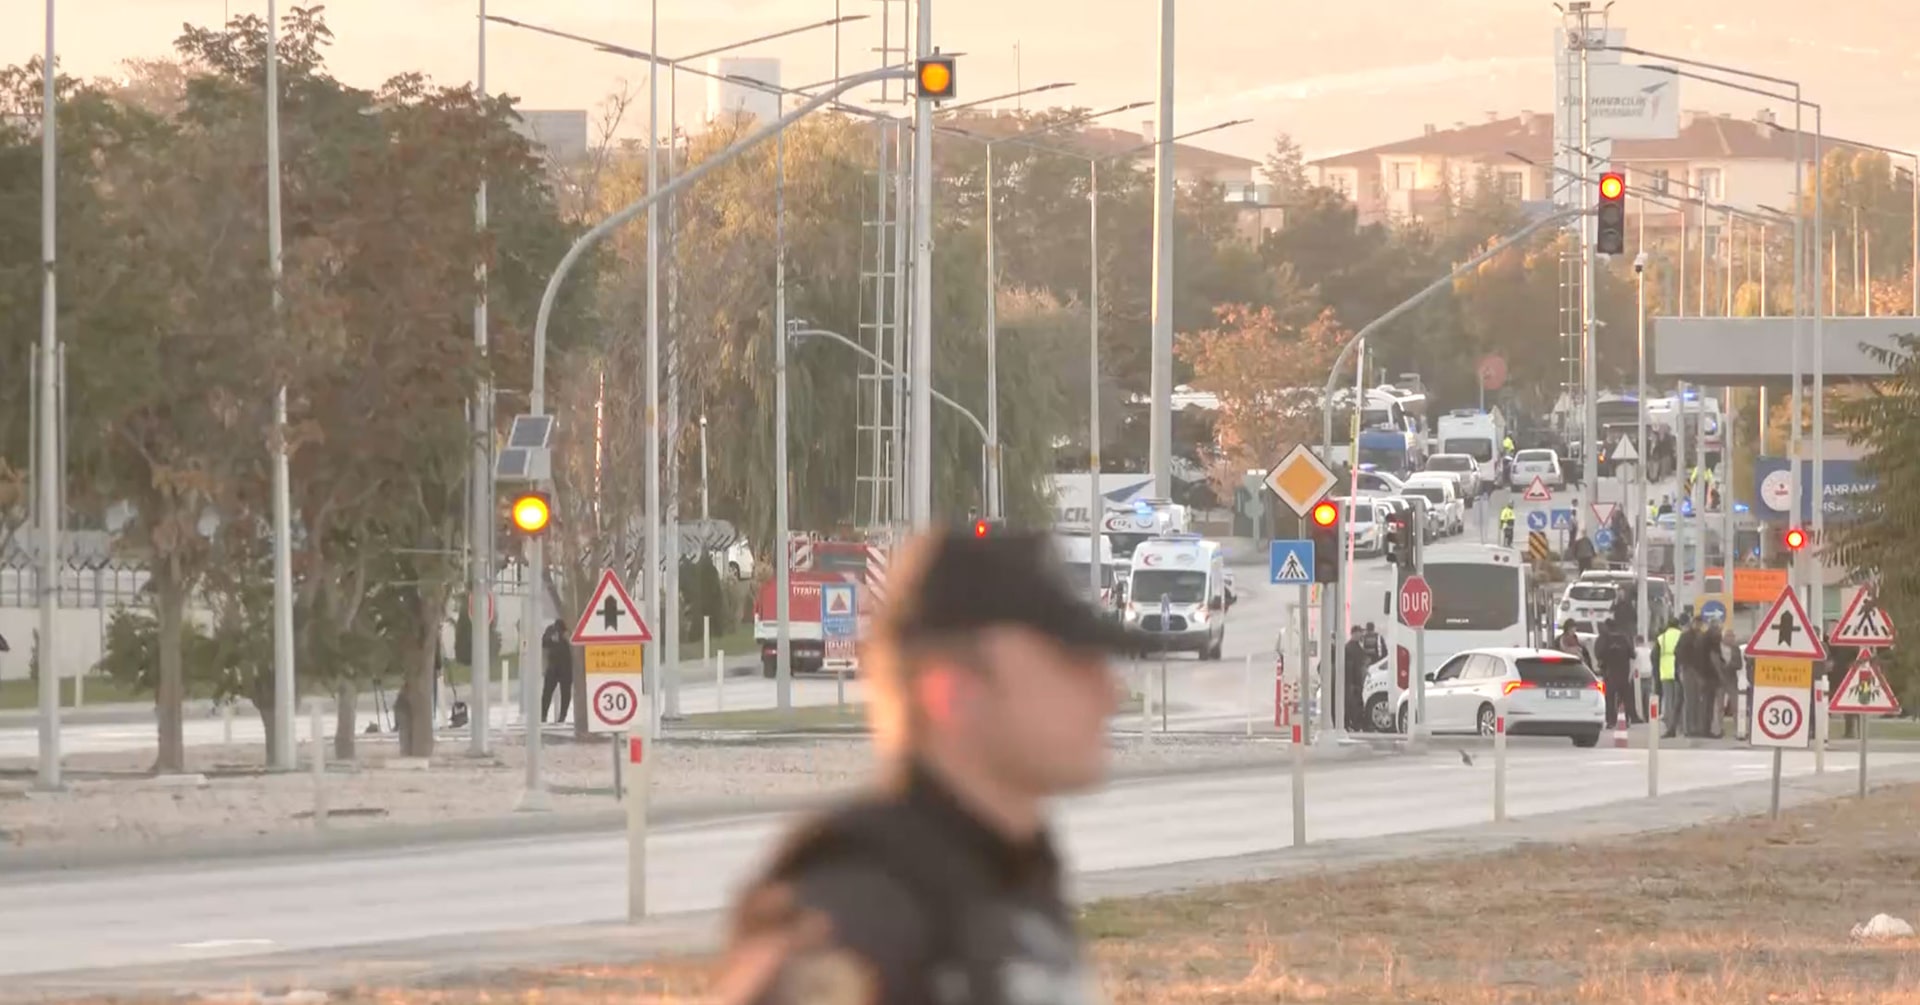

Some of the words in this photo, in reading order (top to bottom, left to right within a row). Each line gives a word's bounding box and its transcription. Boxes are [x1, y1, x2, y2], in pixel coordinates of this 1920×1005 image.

[1402, 591, 1429, 612] DUR
[602, 692, 628, 712] 30
[1768, 706, 1794, 727] 30
